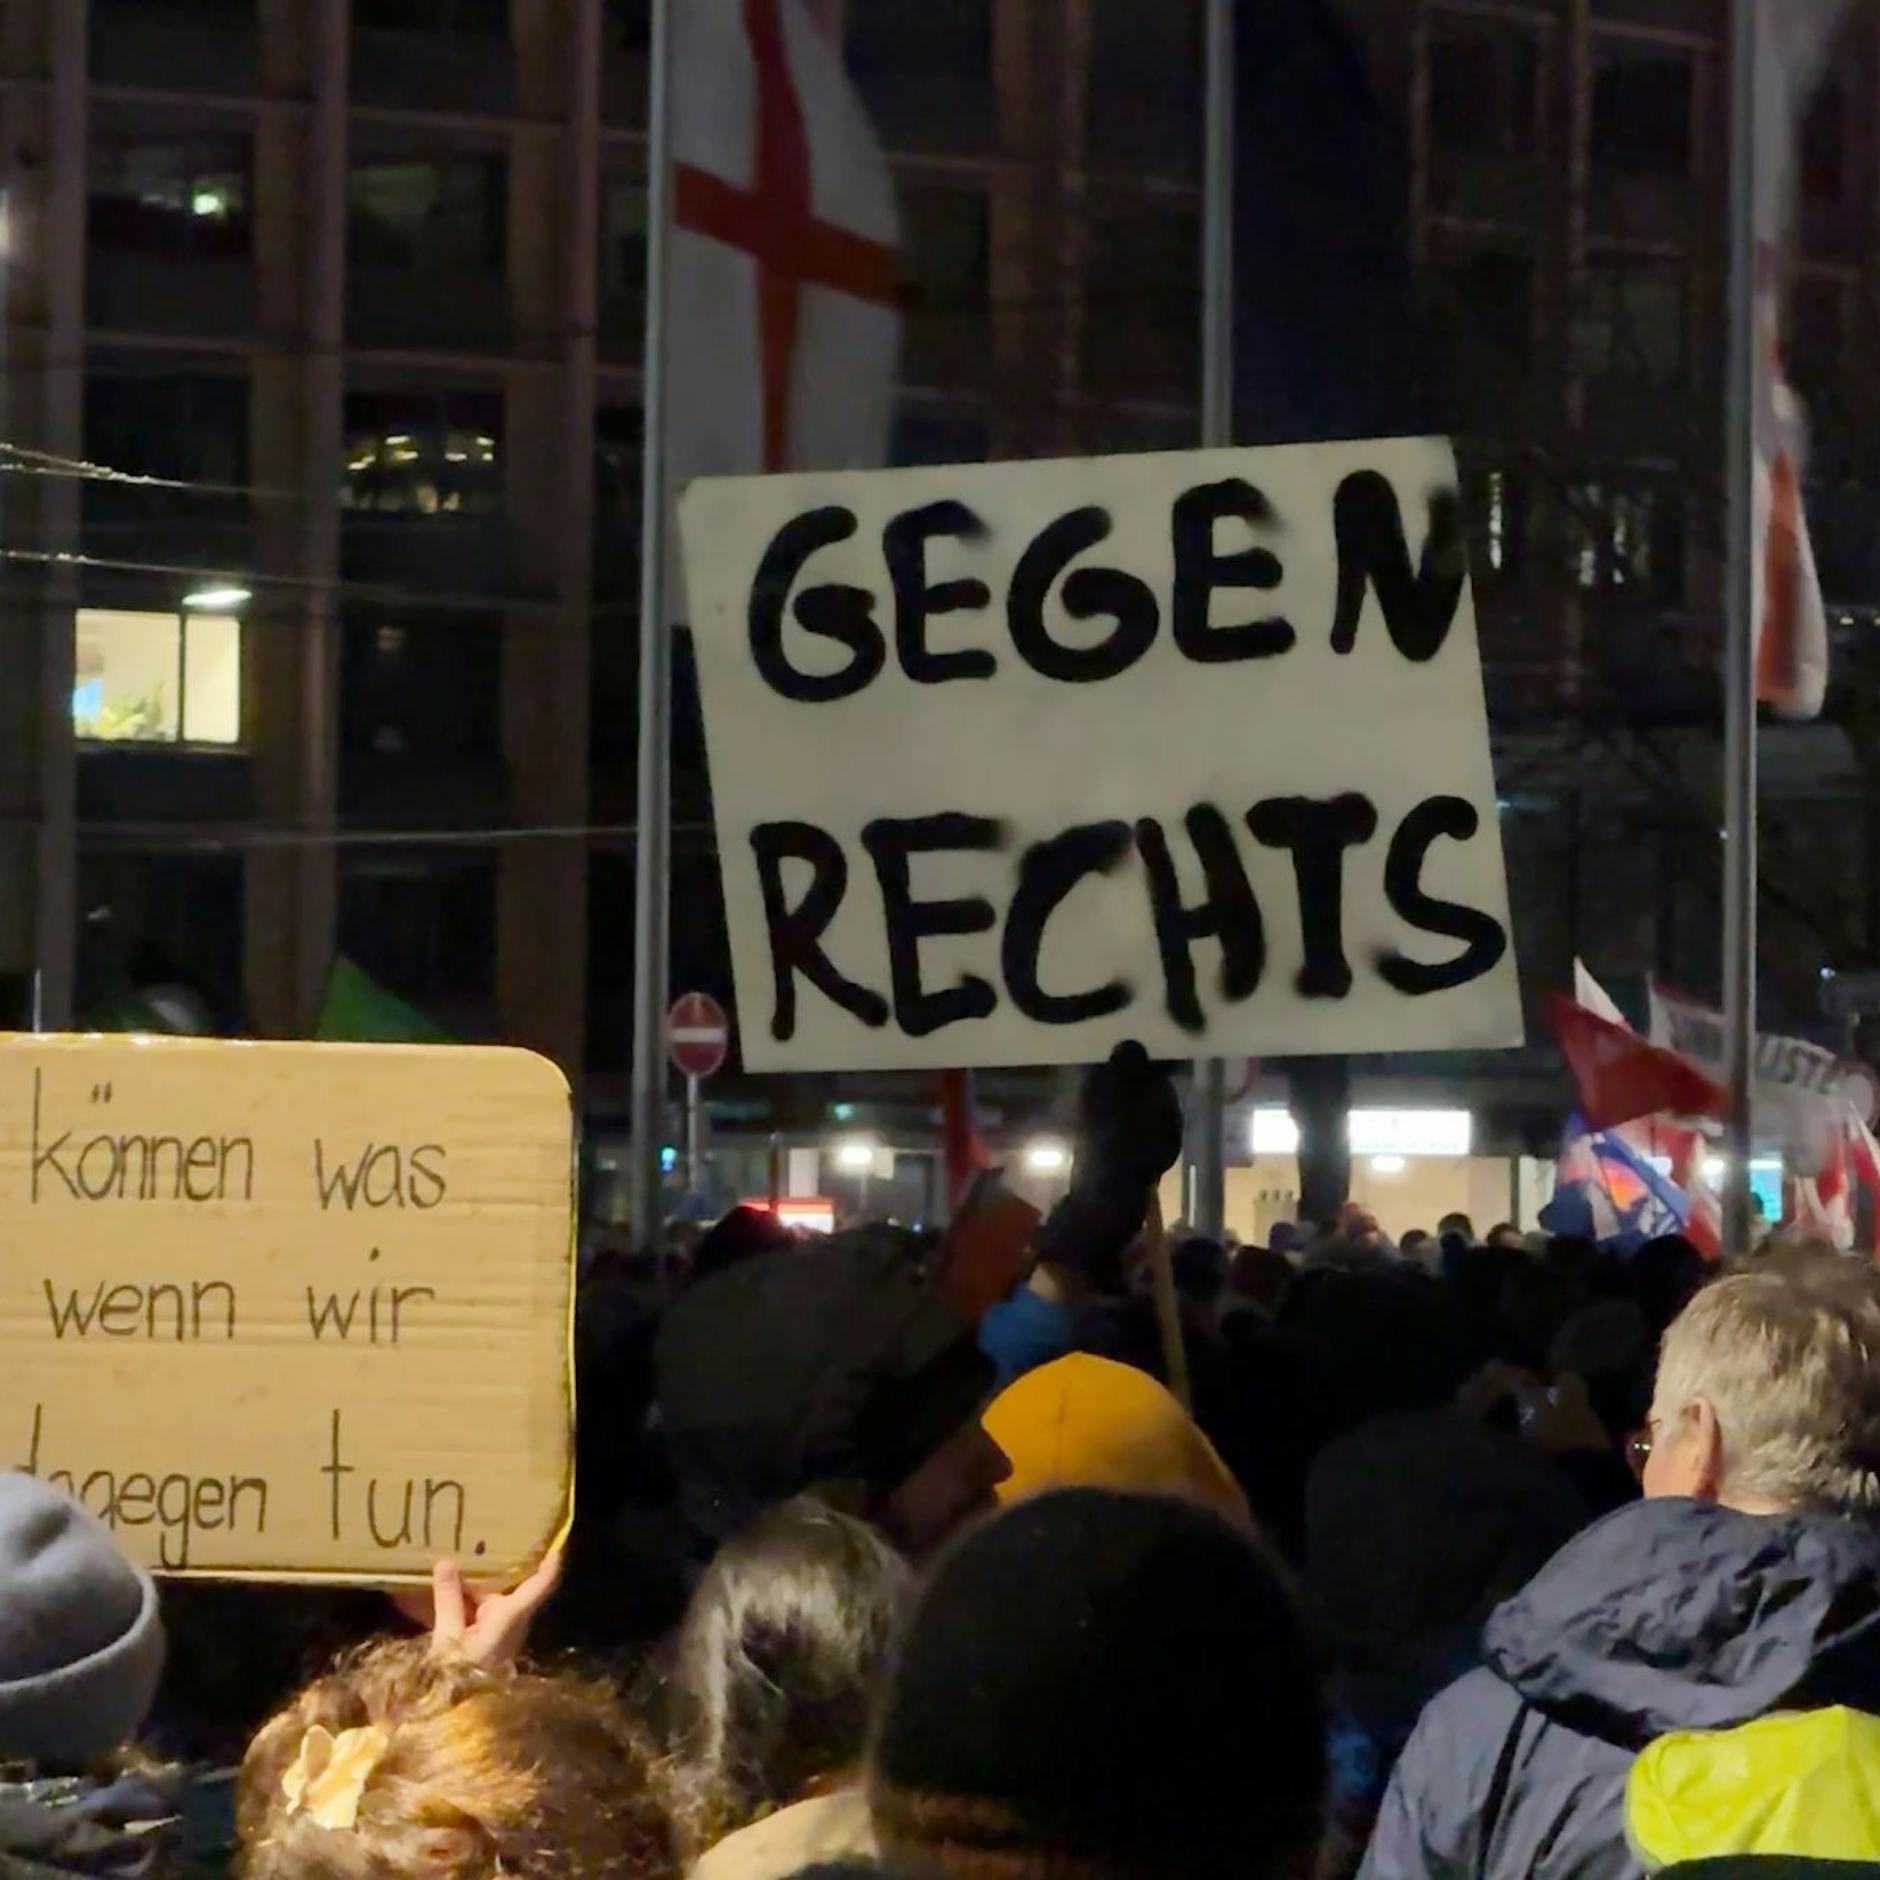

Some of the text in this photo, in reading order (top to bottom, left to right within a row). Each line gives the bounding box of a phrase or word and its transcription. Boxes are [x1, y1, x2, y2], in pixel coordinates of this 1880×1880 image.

[748, 469, 1467, 703] GEGEN
[749, 792, 1506, 1041] RECHTS
[31, 1066, 446, 1210] können was
[43, 1247, 436, 1344] wenn wir
[321, 1408, 487, 1556] tun.
